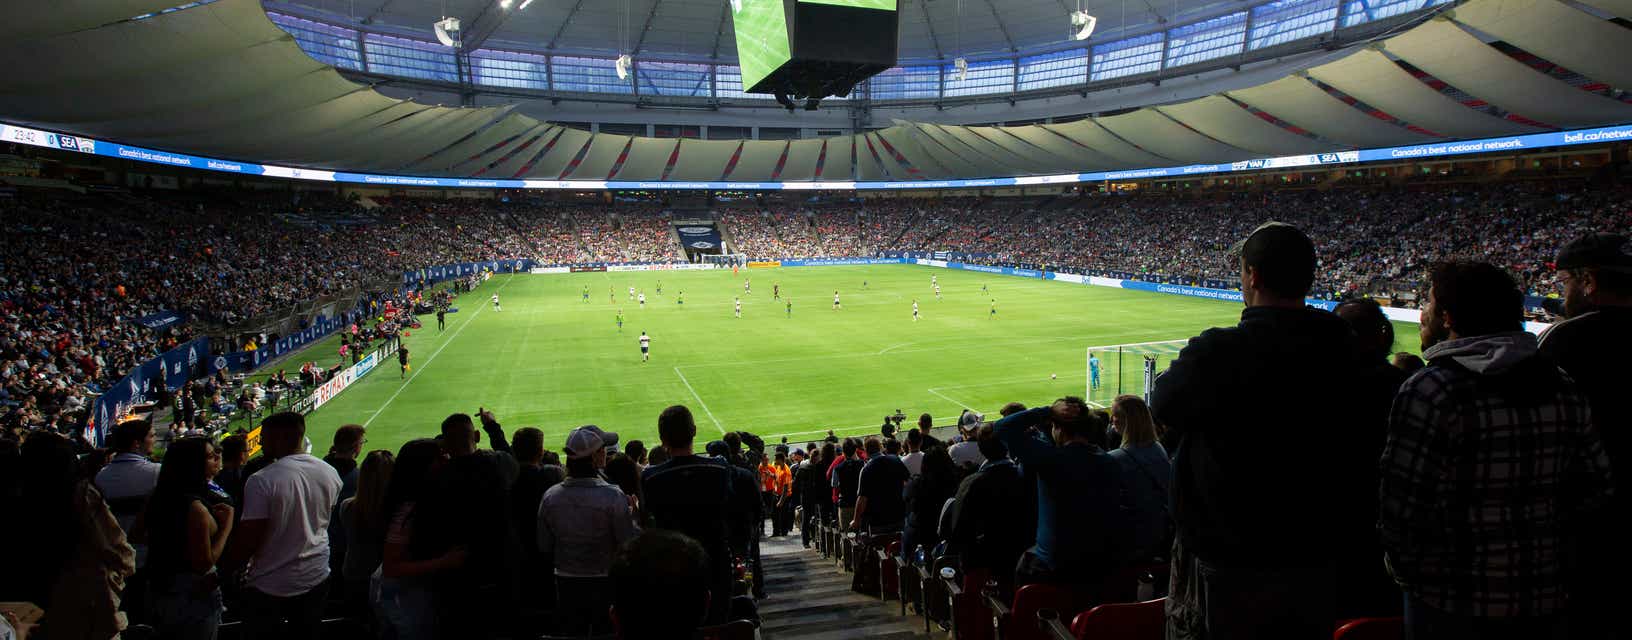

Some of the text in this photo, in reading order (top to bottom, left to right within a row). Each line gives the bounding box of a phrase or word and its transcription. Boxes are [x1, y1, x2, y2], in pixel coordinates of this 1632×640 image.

[60, 136, 77, 149] SEA
[1391, 146, 1428, 157] Canada's
[1429, 144, 1447, 154] best
[1448, 142, 1483, 153] national
[1249, 159, 1264, 169] VAN
[1322, 154, 1337, 162] SEA
[1157, 284, 1180, 294] Canada's
[1182, 287, 1194, 295] best
[1194, 289, 1218, 298] national
[320, 374, 345, 402] RE/MAX
